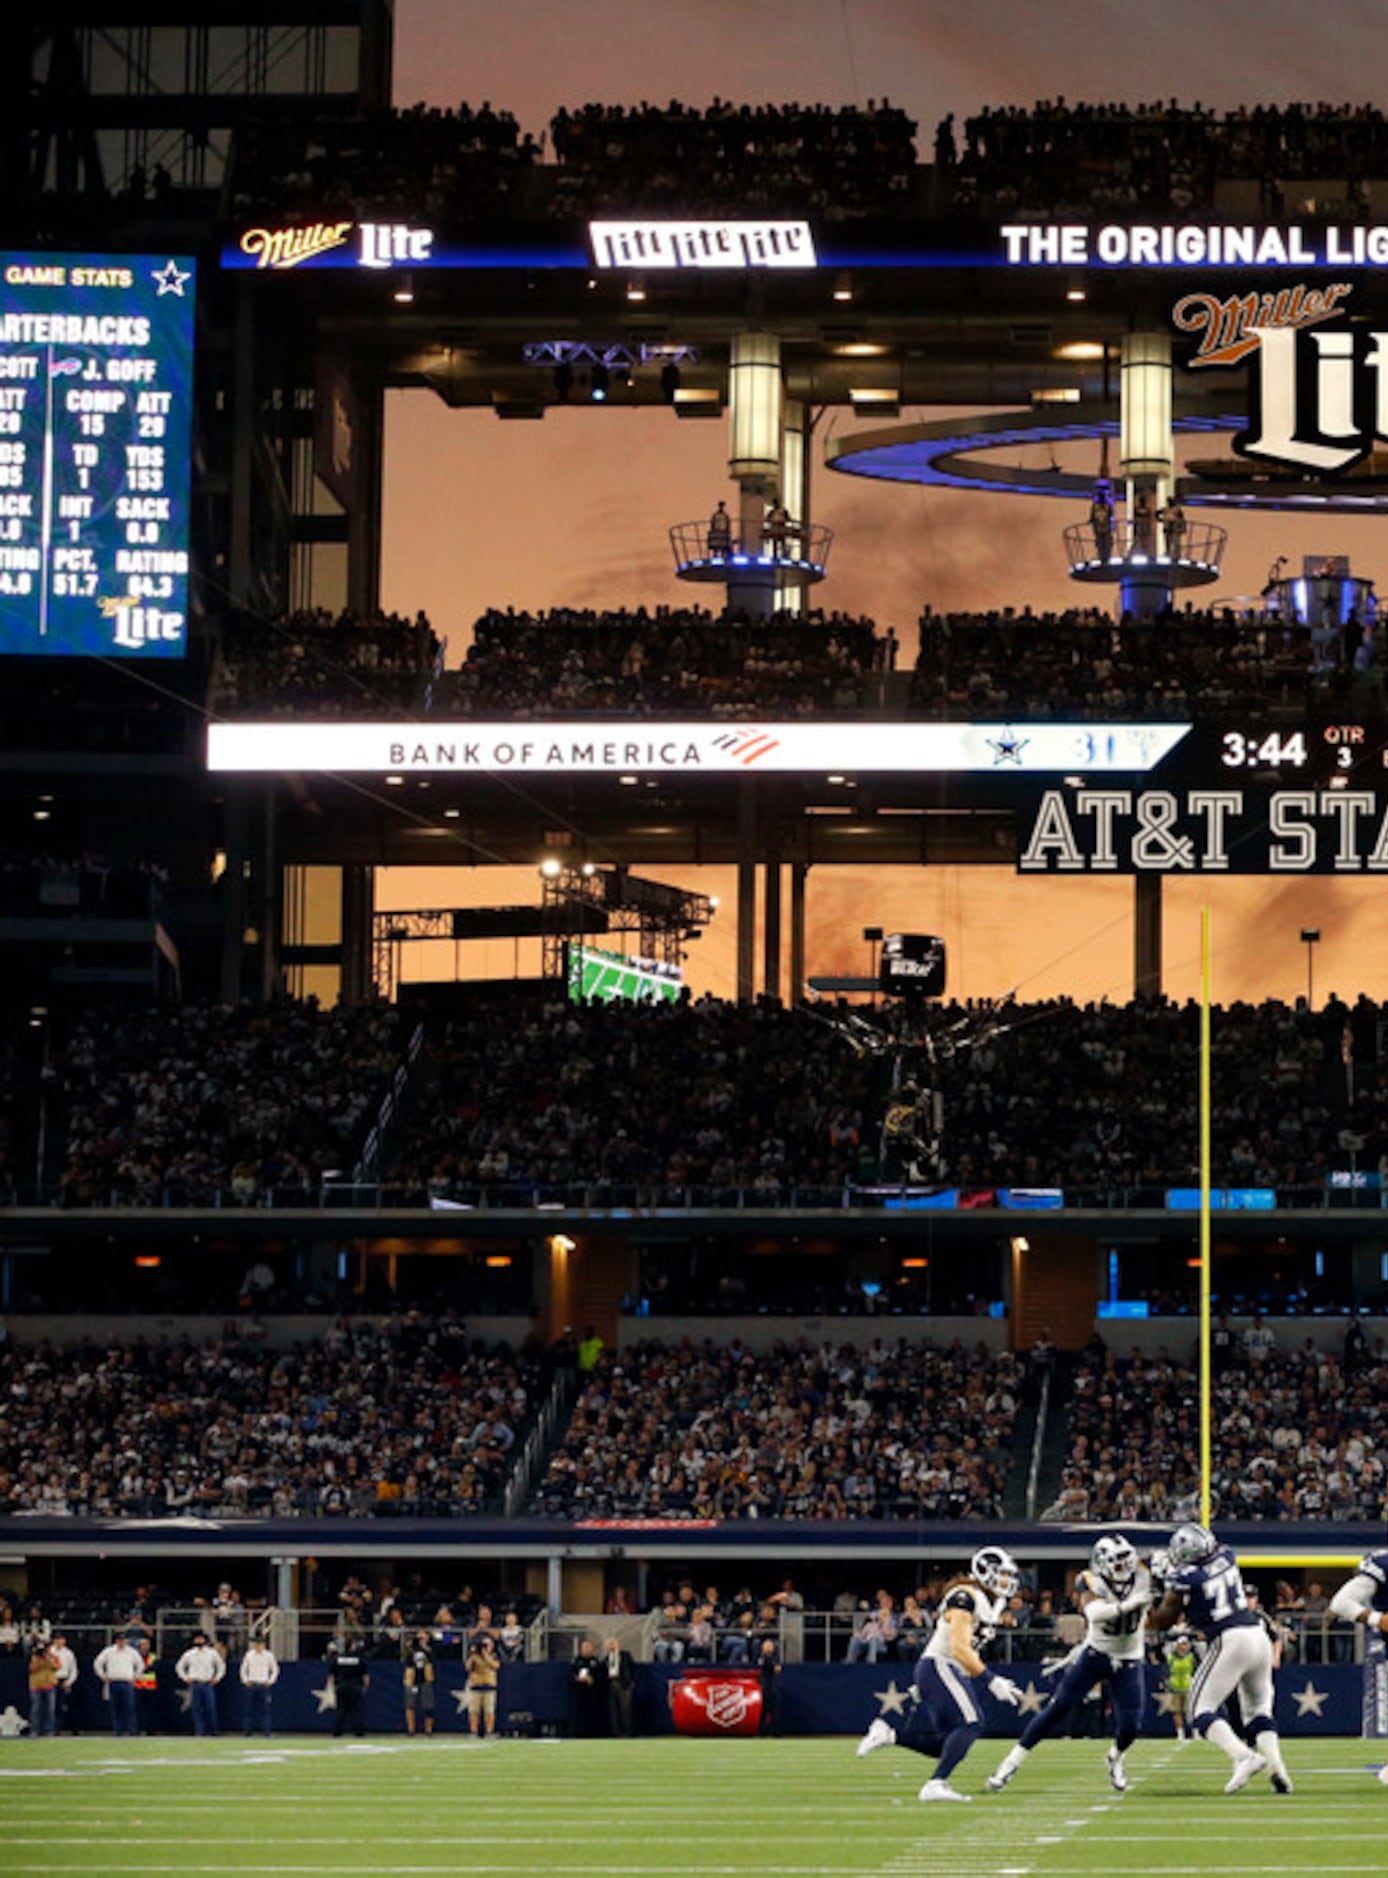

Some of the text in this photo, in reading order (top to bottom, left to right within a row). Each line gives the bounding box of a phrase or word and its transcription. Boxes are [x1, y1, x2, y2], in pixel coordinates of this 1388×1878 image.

[240, 222, 433, 269] Miller Lite
[1000, 225, 1089, 264] THE
[1098, 225, 1316, 264] ORIGINAL
[5, 265, 133, 288] GAME STATS
[1172, 283, 1352, 368] Miller
[82, 357, 157, 382] J. GOFF
[66, 389, 172, 414] COMP ATT
[80, 414, 105, 436] 15
[72, 443, 165, 468] TD YDS
[78, 467, 164, 491] 1 153
[59, 495, 170, 520] INT SACK
[69, 520, 80, 542] 1
[53, 549, 188, 574] PCT. RATING
[53, 574, 99, 596] 51.7
[113, 606, 184, 649] Lite
[389, 743, 701, 764] BANK OF AMERICA
[1222, 732, 1307, 767] 3:44
[1337, 747, 1351, 768] 3
[1020, 790, 1242, 870] AT&T
